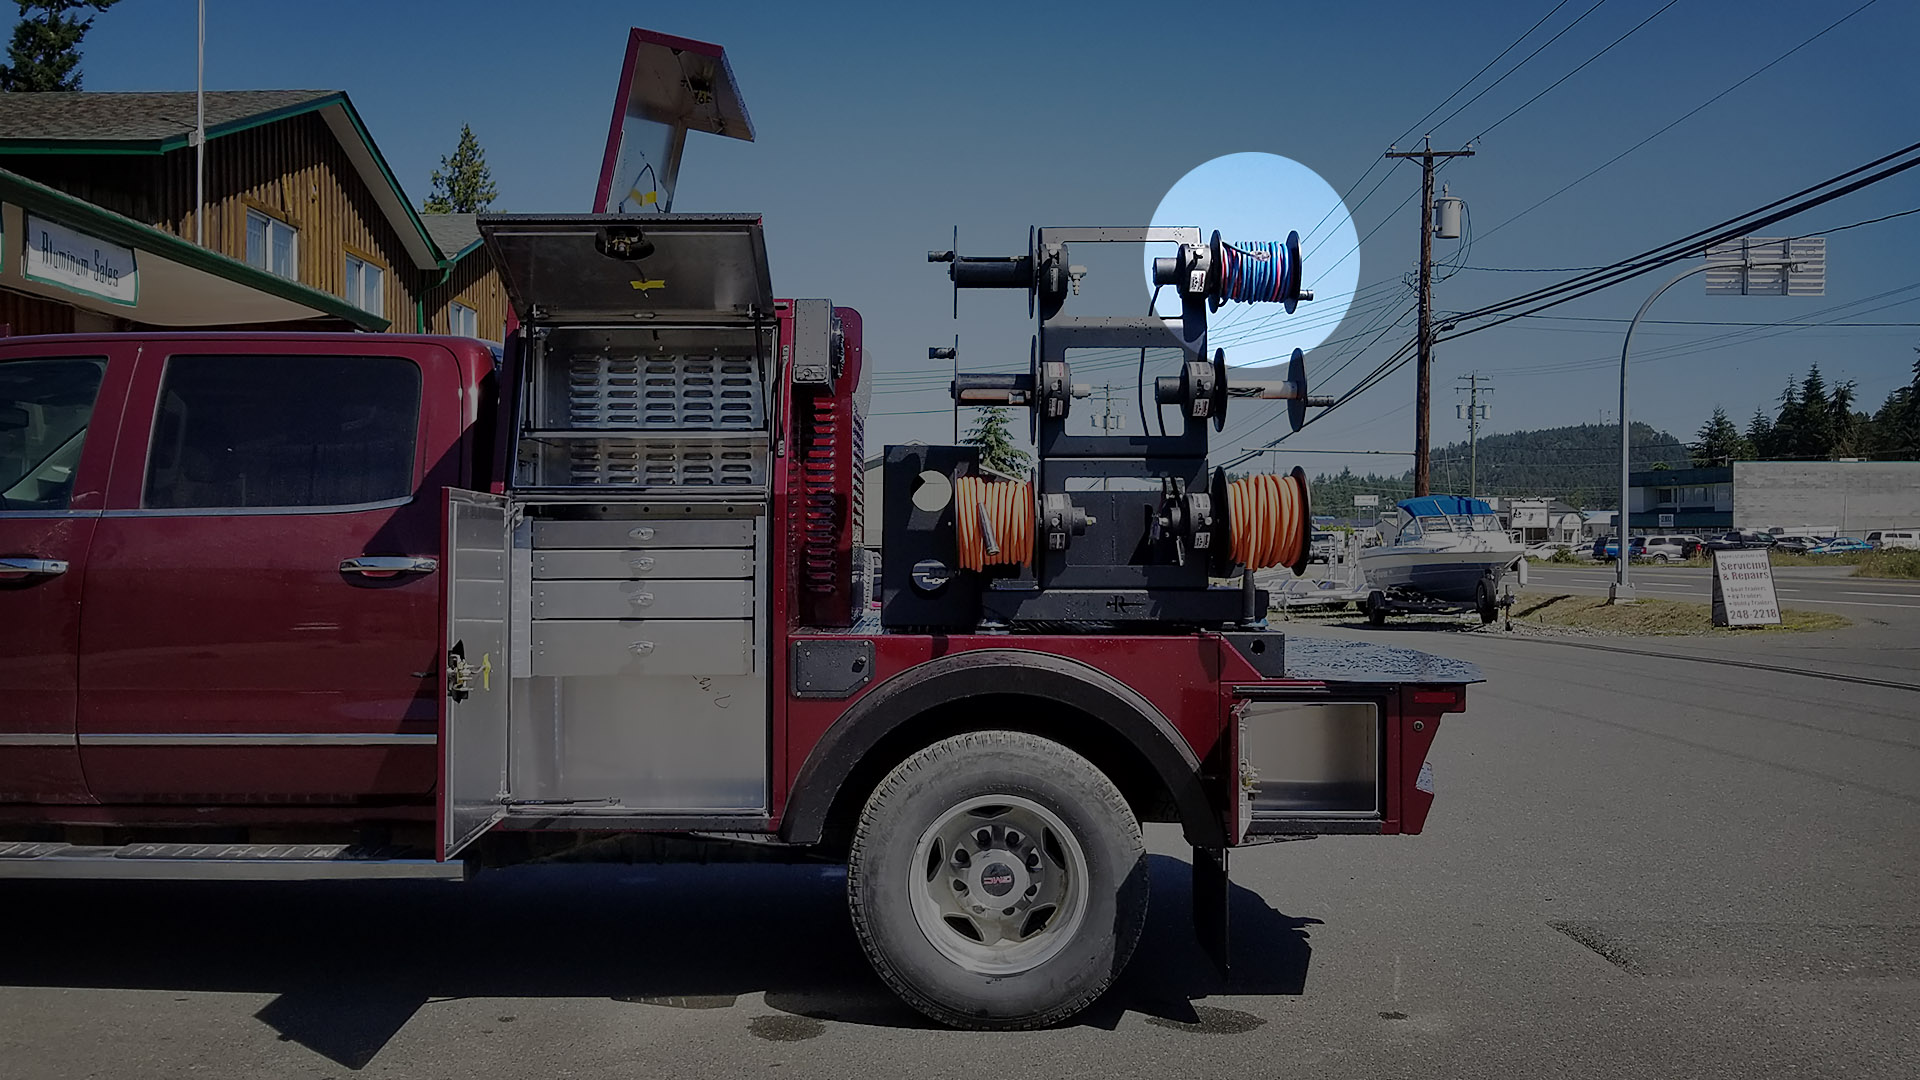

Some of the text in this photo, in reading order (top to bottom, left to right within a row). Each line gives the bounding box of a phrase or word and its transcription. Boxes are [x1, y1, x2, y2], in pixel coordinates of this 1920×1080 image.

[41, 231, 119, 288] Aluminum Sales
[1720, 562, 1768, 571] Servicing
[1723, 571, 1769, 581] & Repairs
[1730, 608, 1777, 620] 248-2218
